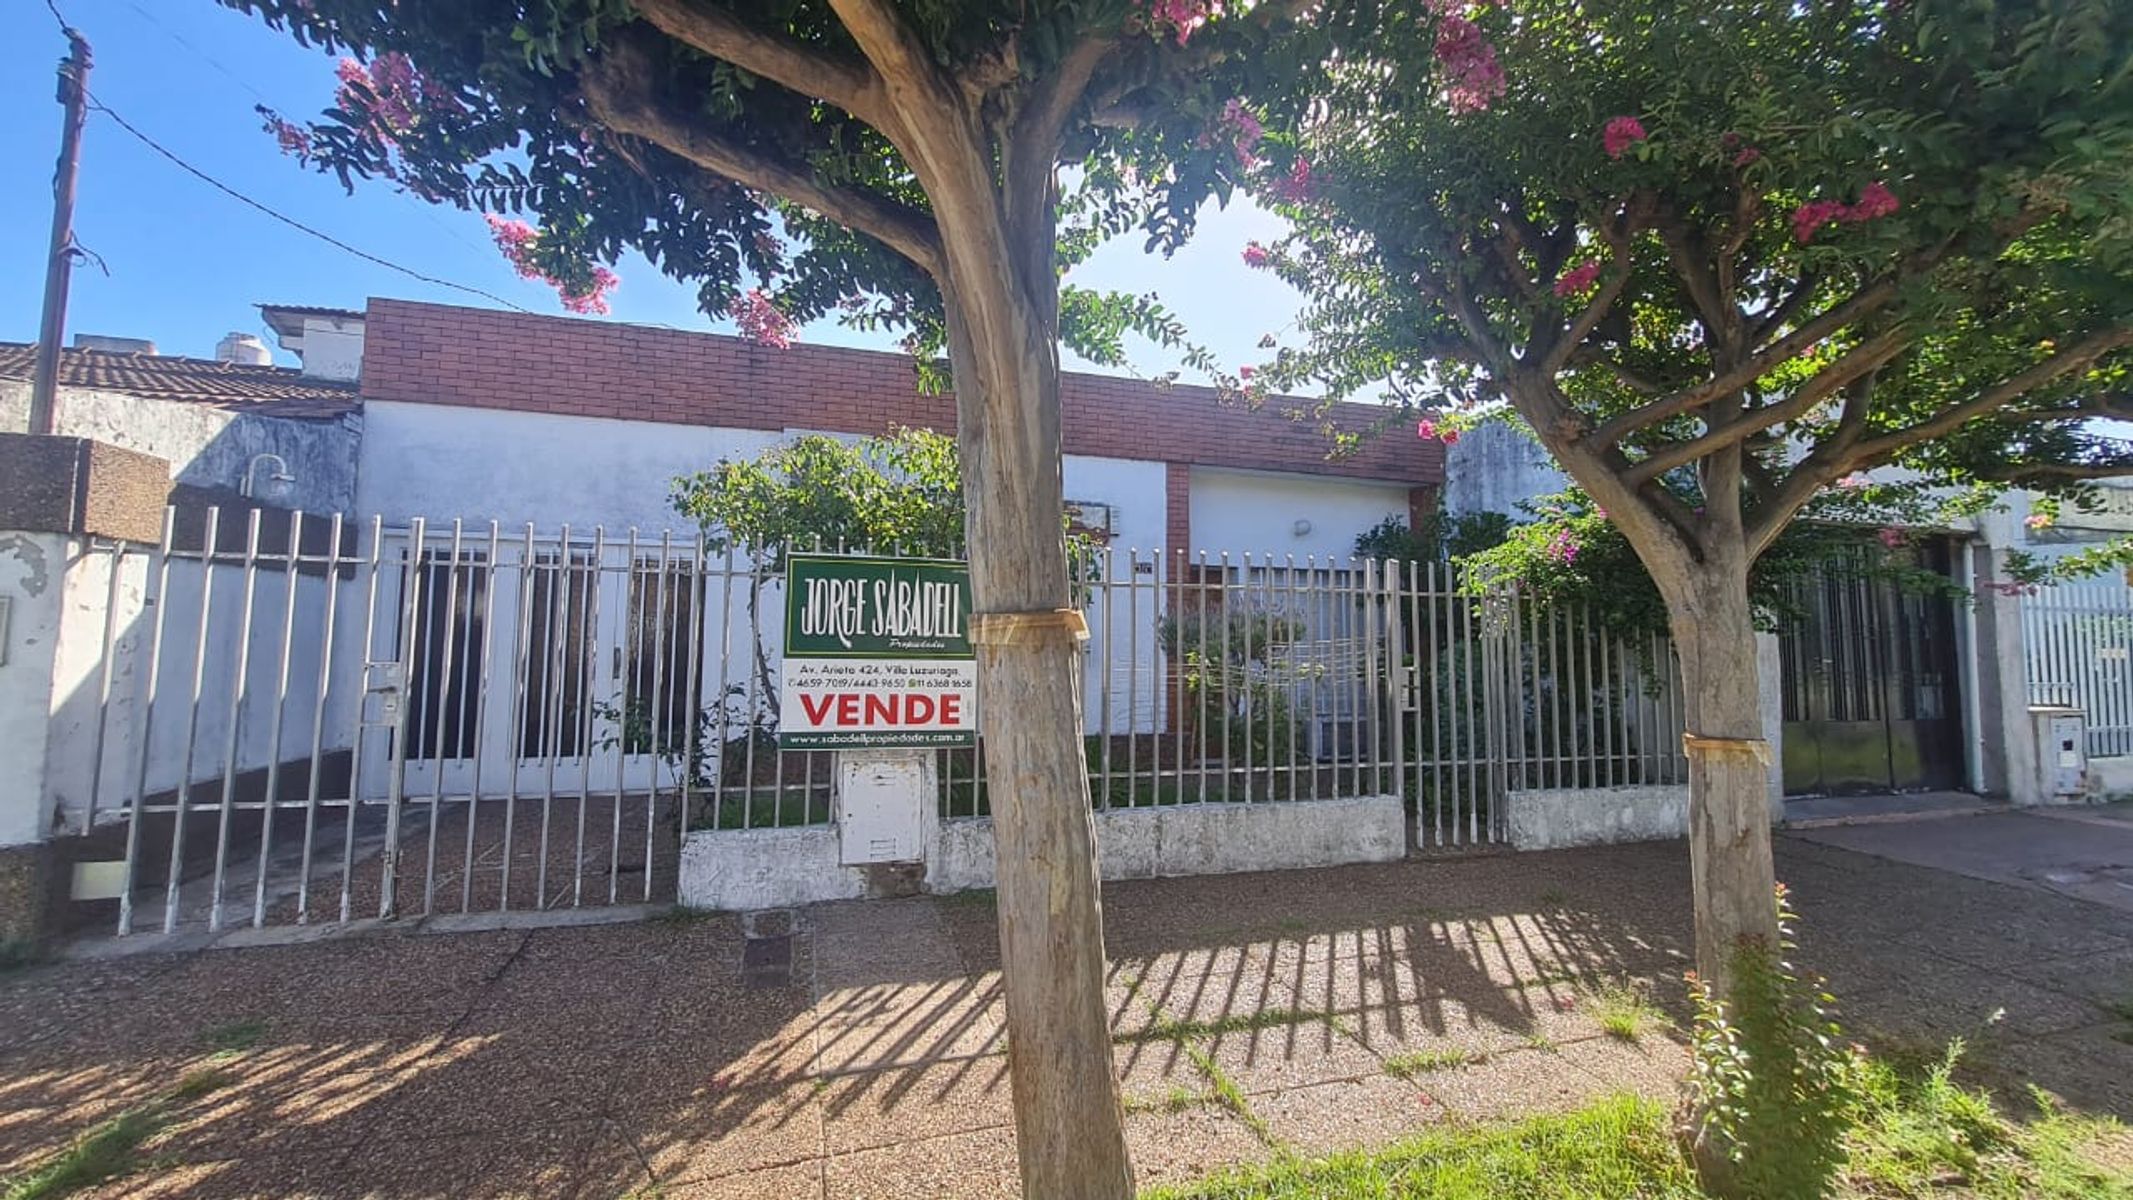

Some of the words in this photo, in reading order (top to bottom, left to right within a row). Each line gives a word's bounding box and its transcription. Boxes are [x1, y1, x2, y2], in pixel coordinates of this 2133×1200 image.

[802, 578, 868, 648] JORGE
[872, 567, 961, 638] SABADELL
[800, 693, 961, 726] VENDE
[790, 733, 965, 746] www.sabadellpropiedades.com.ar
